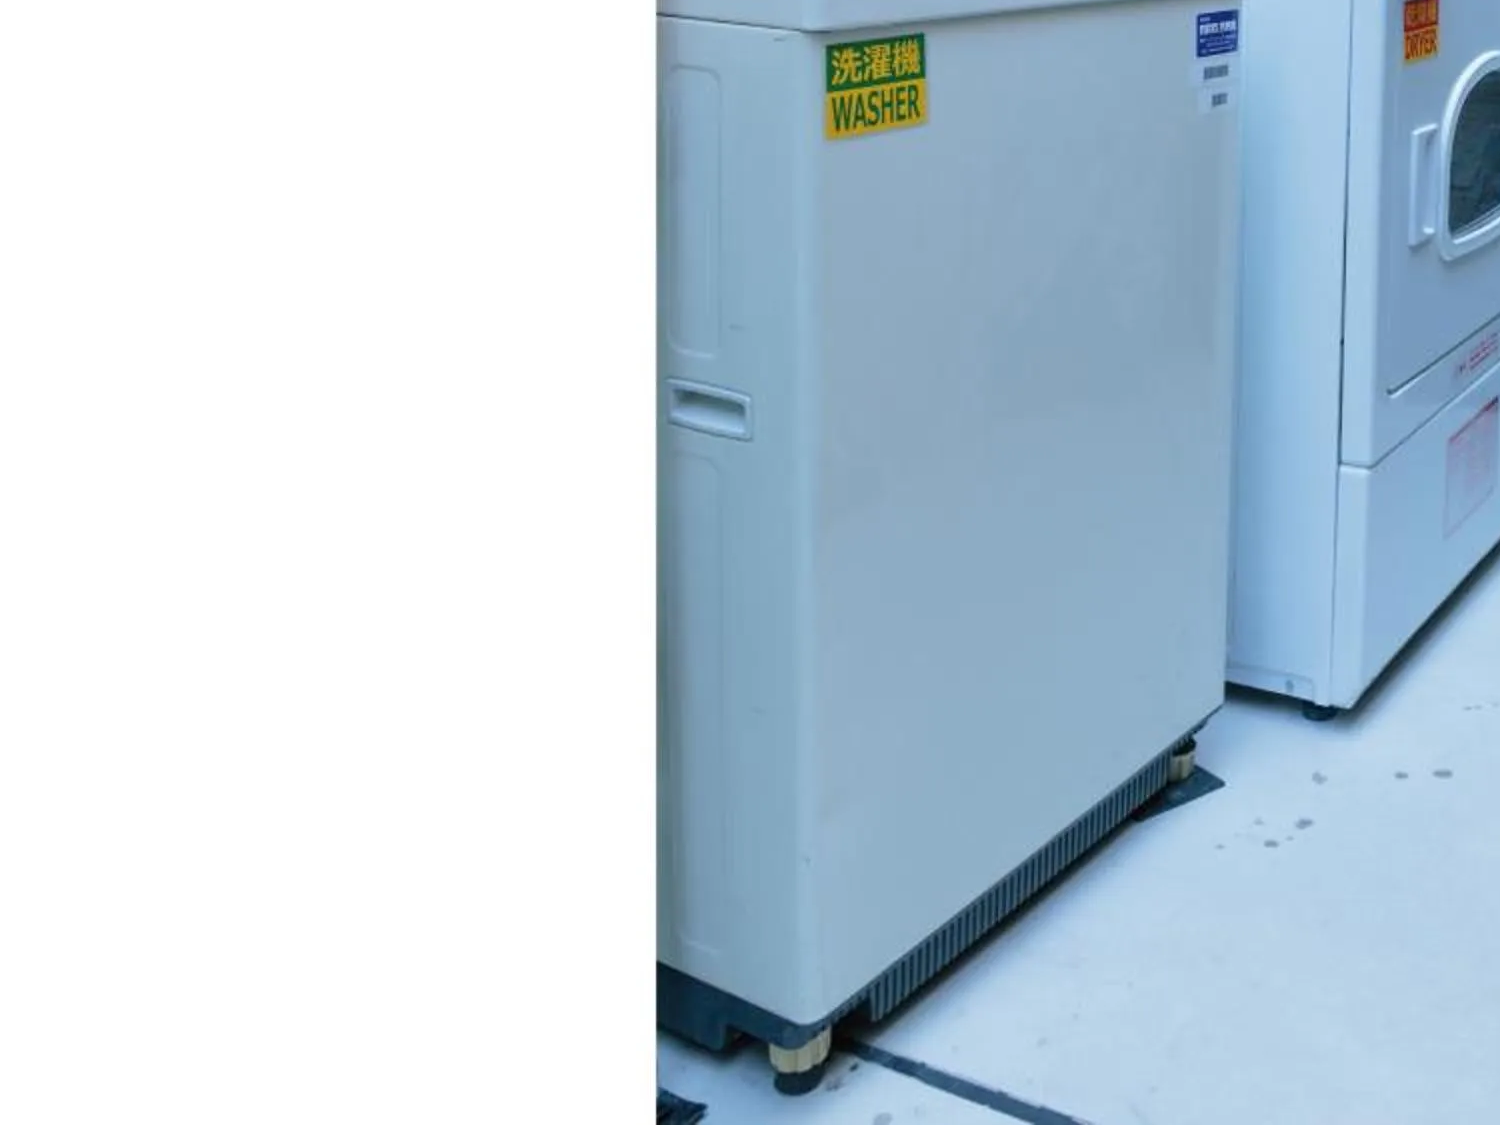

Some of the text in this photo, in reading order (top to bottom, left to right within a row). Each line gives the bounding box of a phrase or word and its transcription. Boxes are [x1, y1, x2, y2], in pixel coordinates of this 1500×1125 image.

[831, 40, 920, 86] 洗濯機
[831, 85, 921, 132] WASHER
